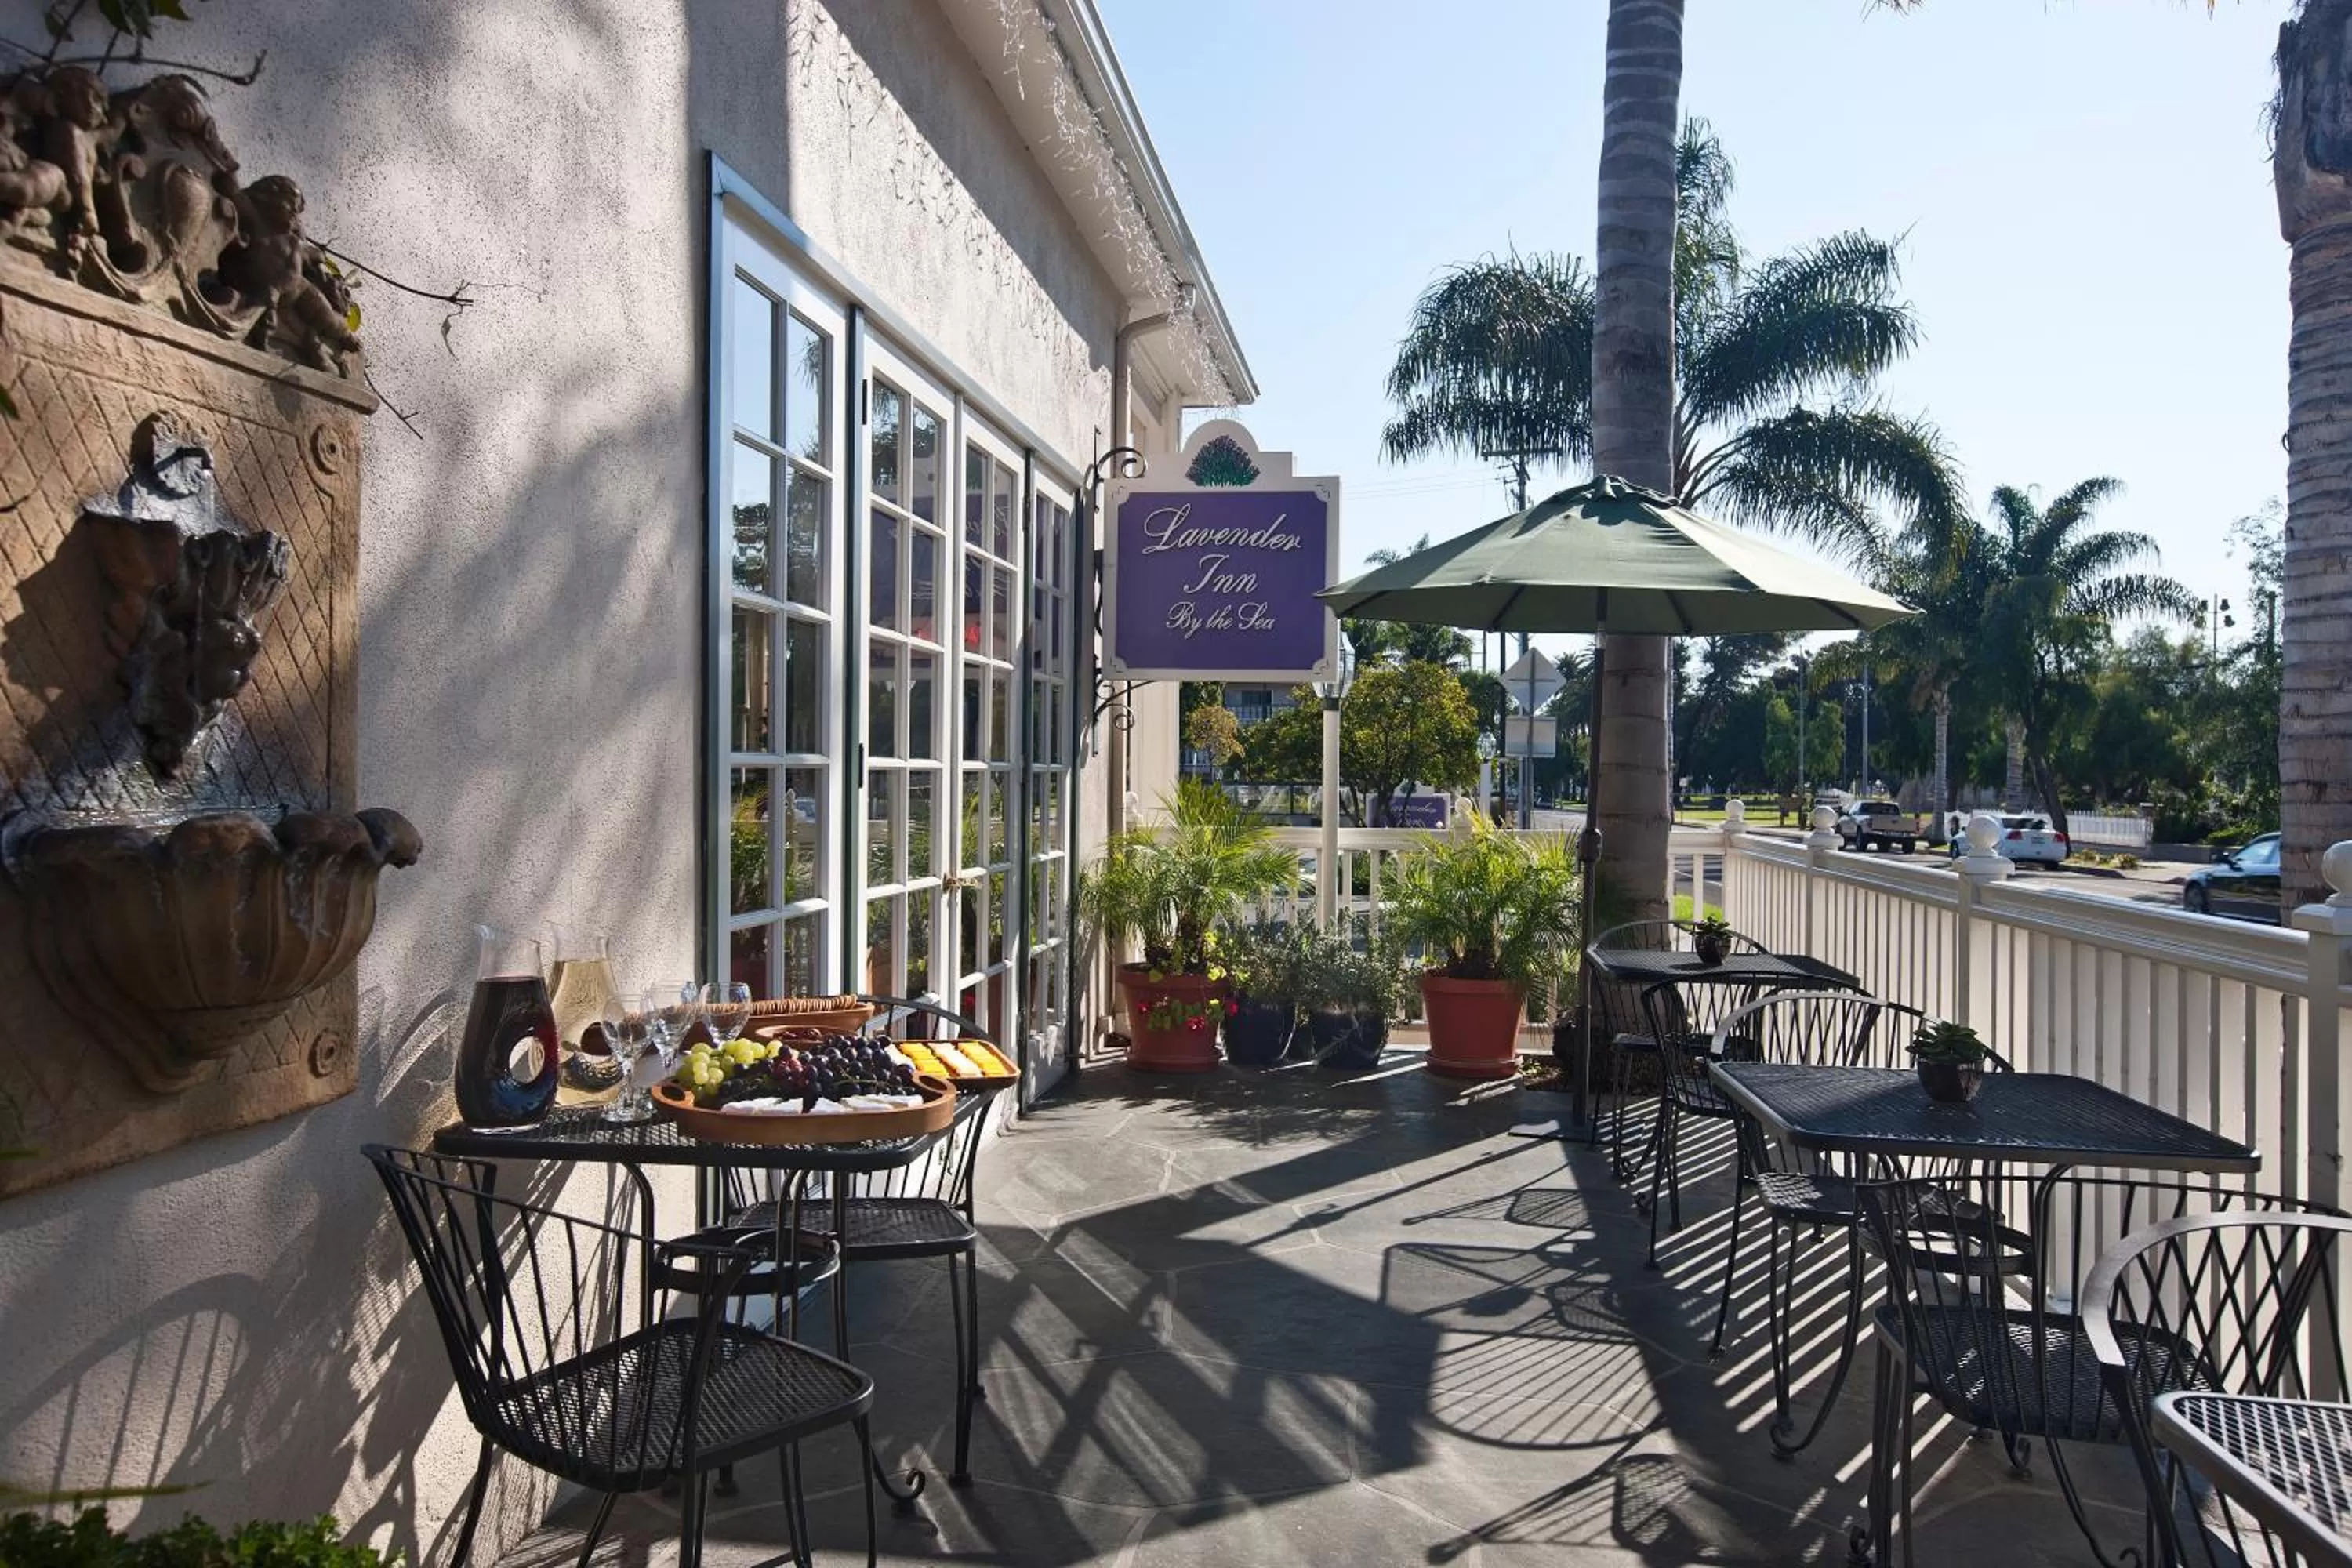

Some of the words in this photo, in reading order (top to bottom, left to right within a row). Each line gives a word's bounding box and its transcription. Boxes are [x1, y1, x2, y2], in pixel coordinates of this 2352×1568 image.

[1142, 503, 1301, 554] Lavender
[1184, 554, 1258, 593] Inn
[1166, 602, 1203, 639] By
[1205, 605, 1233, 630] the
[1238, 602, 1275, 630] Sea
